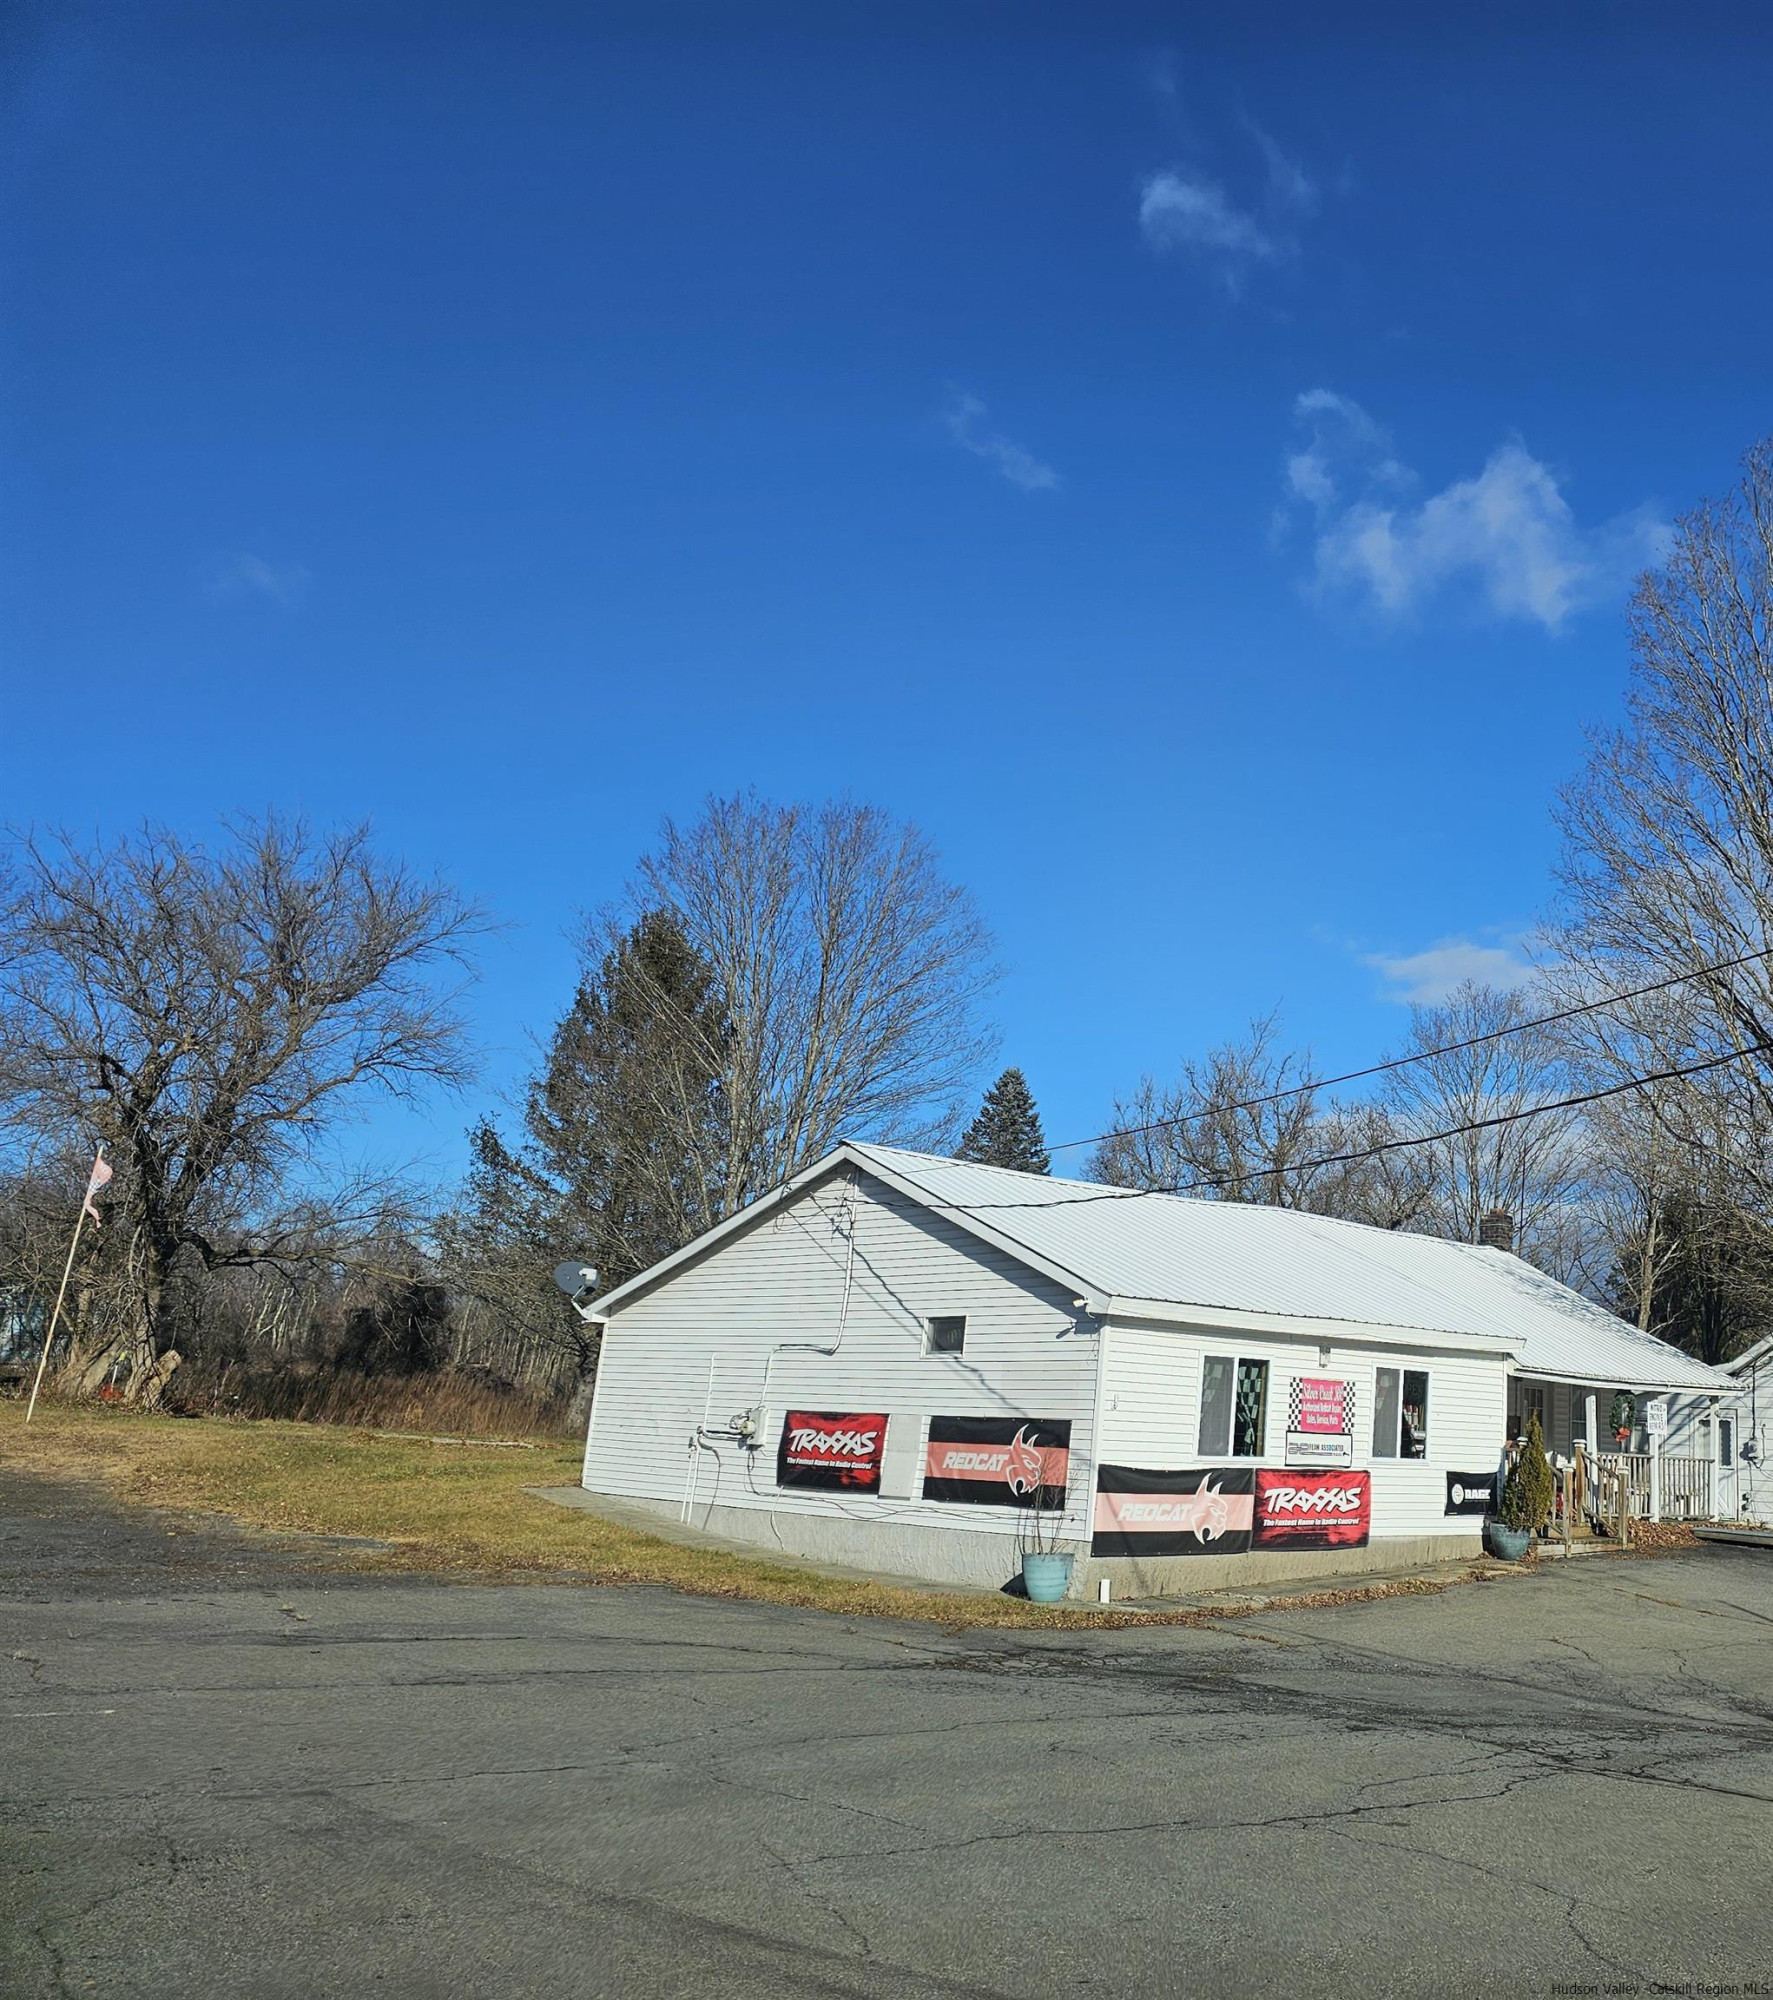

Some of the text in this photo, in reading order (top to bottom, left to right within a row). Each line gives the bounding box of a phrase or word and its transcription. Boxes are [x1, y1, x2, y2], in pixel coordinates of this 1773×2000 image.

[789, 1428, 879, 1455] TRAXXAS
[1321, 1444, 1344, 1452] ASSOCIATED
[941, 1451, 1009, 1472] REDCAT
[1264, 1487, 1362, 1515] TRAXXAS
[1464, 1489, 1491, 1499] RAGE
[1118, 1503, 1193, 1522] REDCAT
[1263, 1519, 1274, 1527] The
